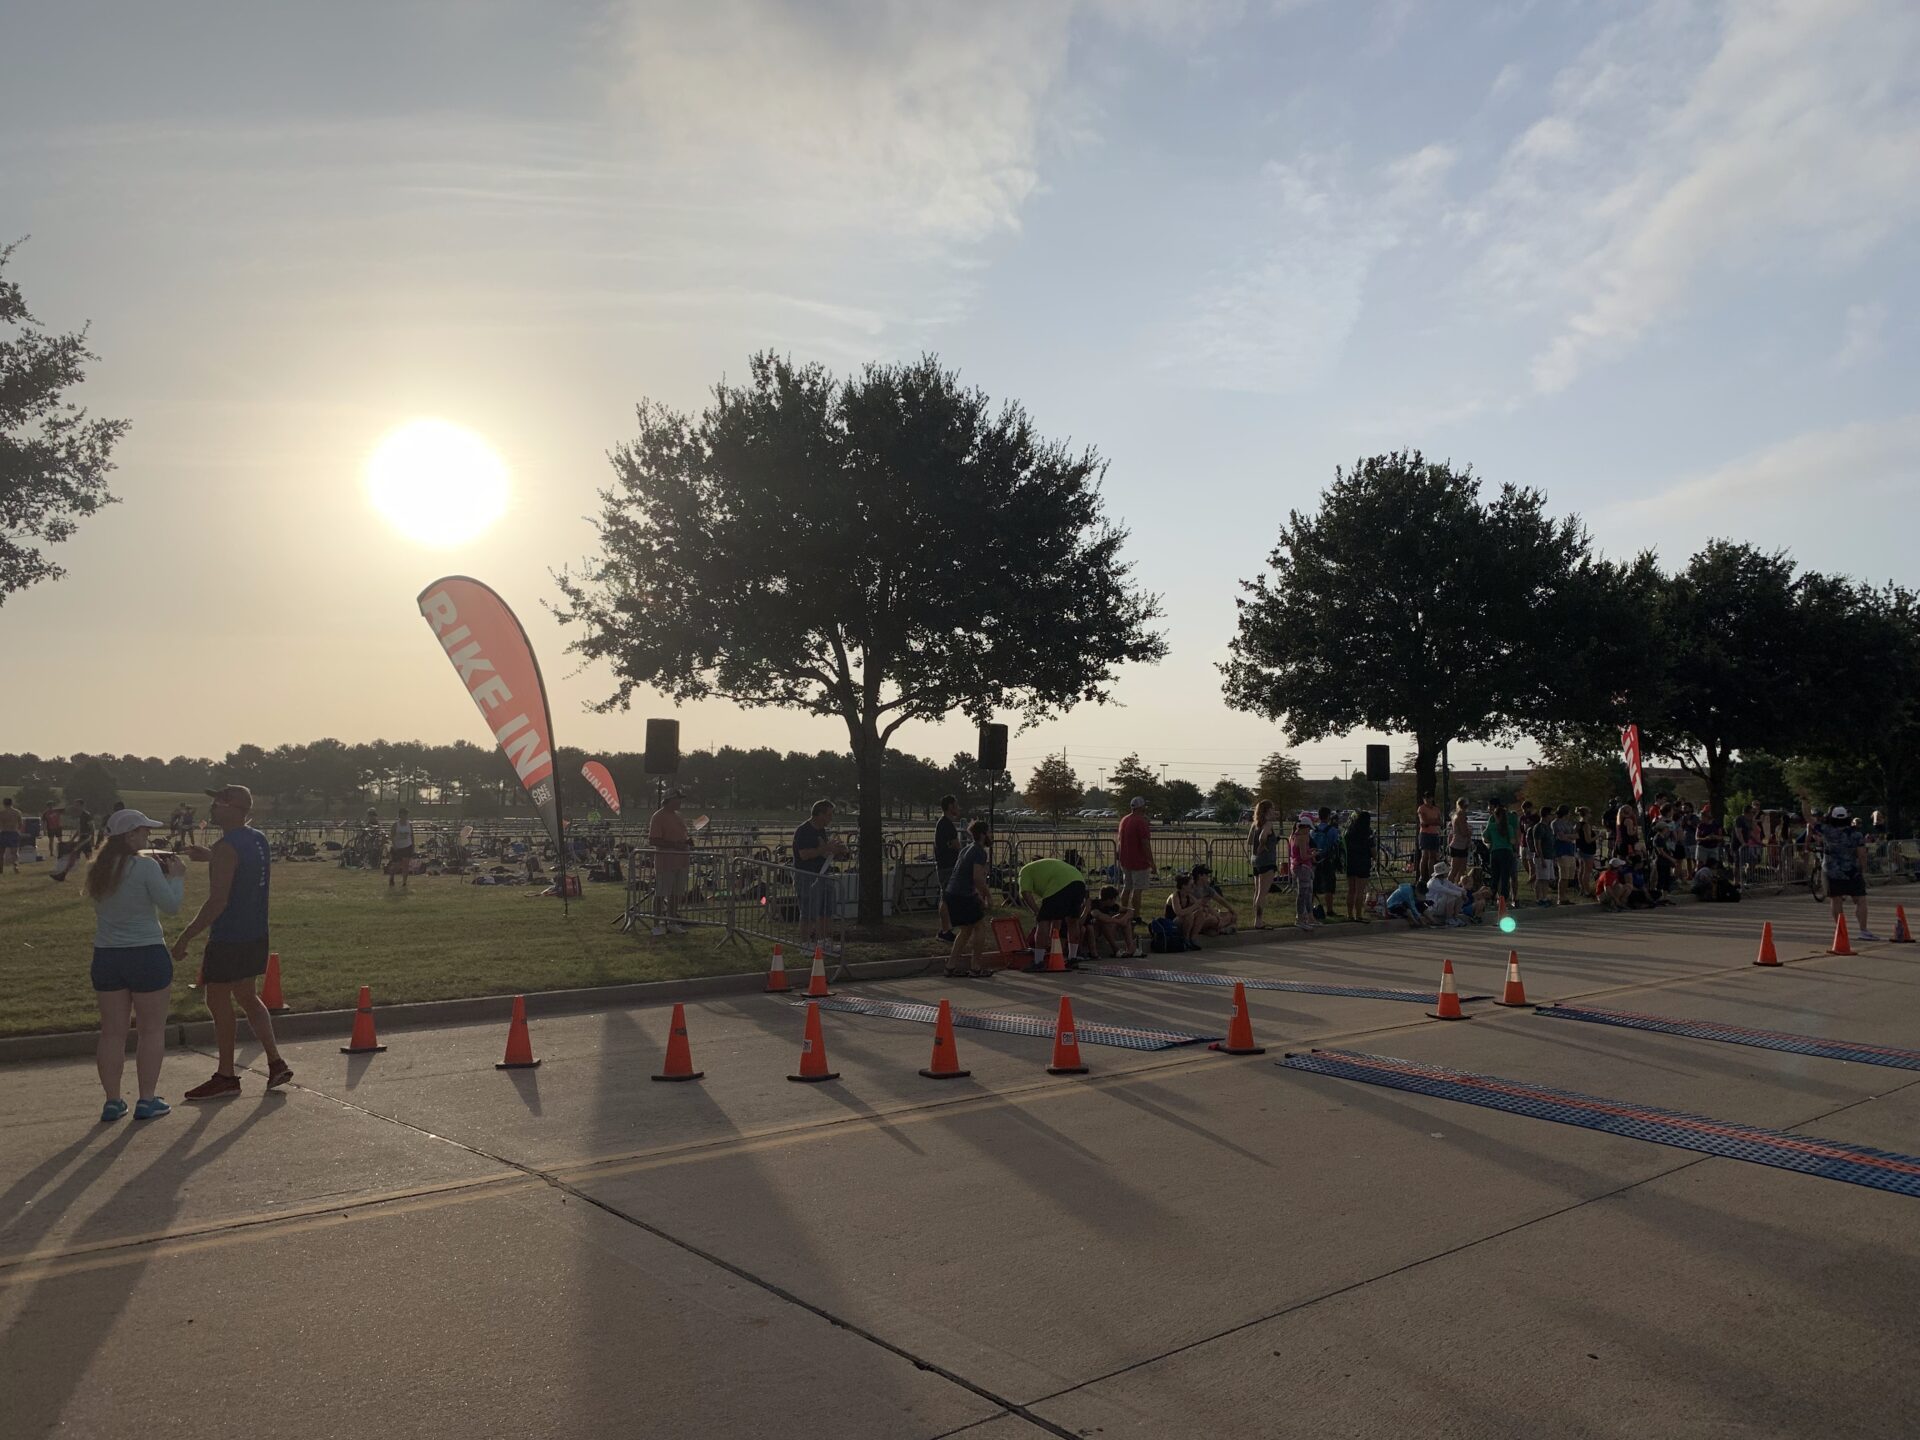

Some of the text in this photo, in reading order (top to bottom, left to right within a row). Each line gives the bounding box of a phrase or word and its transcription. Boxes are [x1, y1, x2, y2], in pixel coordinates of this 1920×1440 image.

[496, 713, 552, 781] IN
[581, 766, 620, 811] RUN OUT
